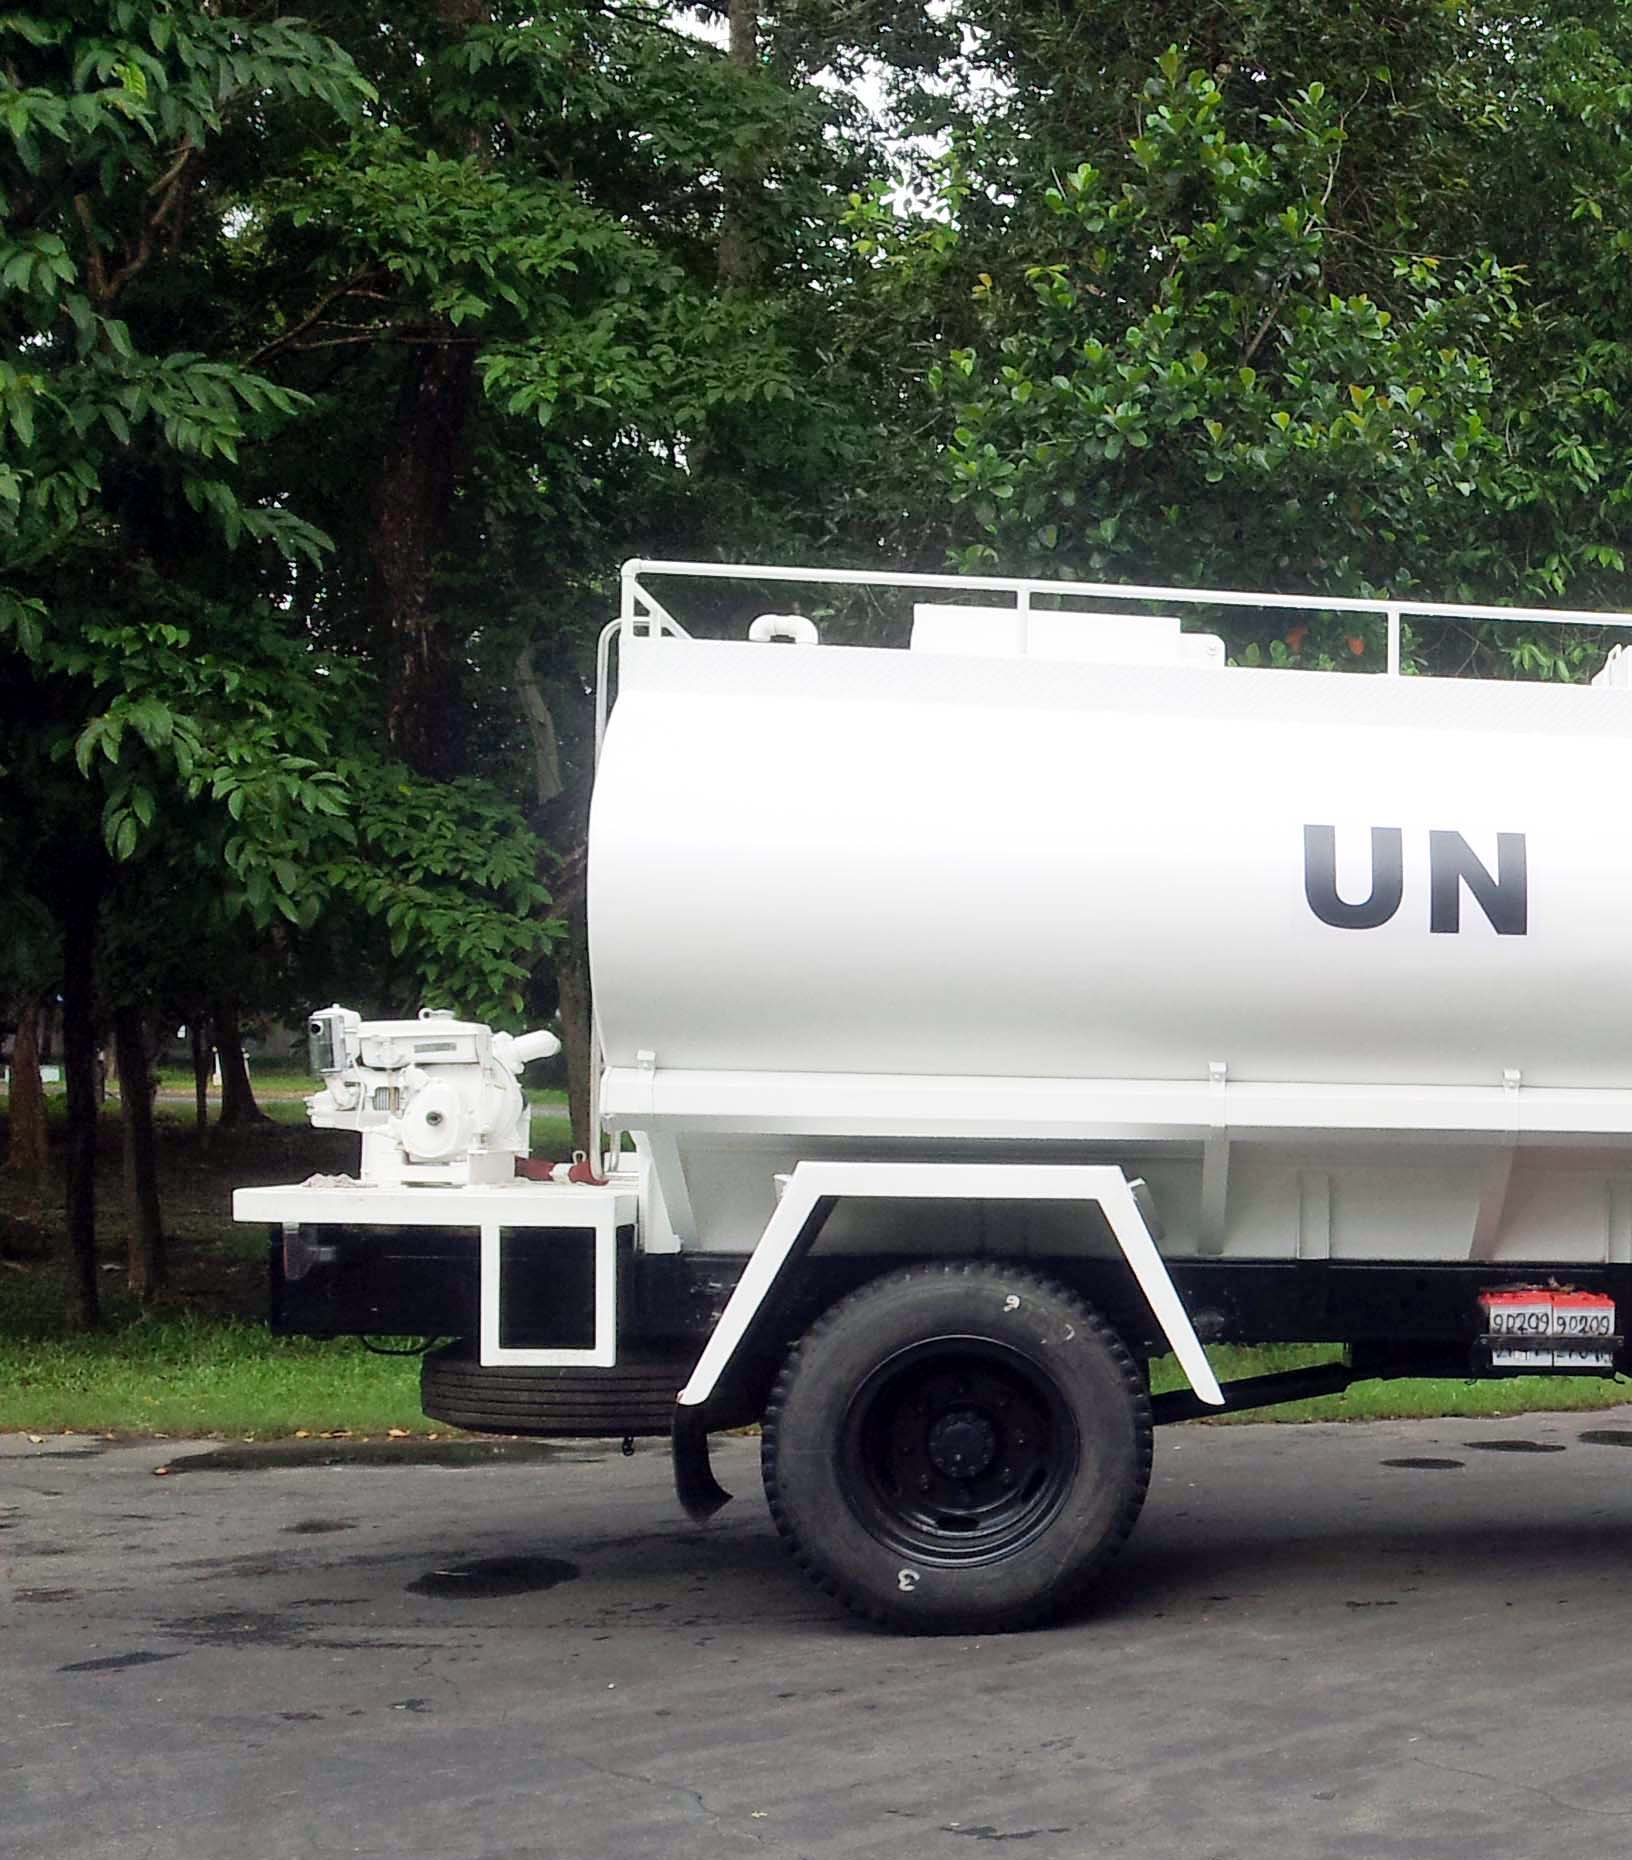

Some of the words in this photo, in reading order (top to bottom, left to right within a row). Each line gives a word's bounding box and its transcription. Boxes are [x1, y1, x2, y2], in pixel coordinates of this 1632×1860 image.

[1303, 824, 1528, 935] UN
[1493, 1312, 1550, 1334] 90209
[1556, 1315, 1610, 1336] 90209
